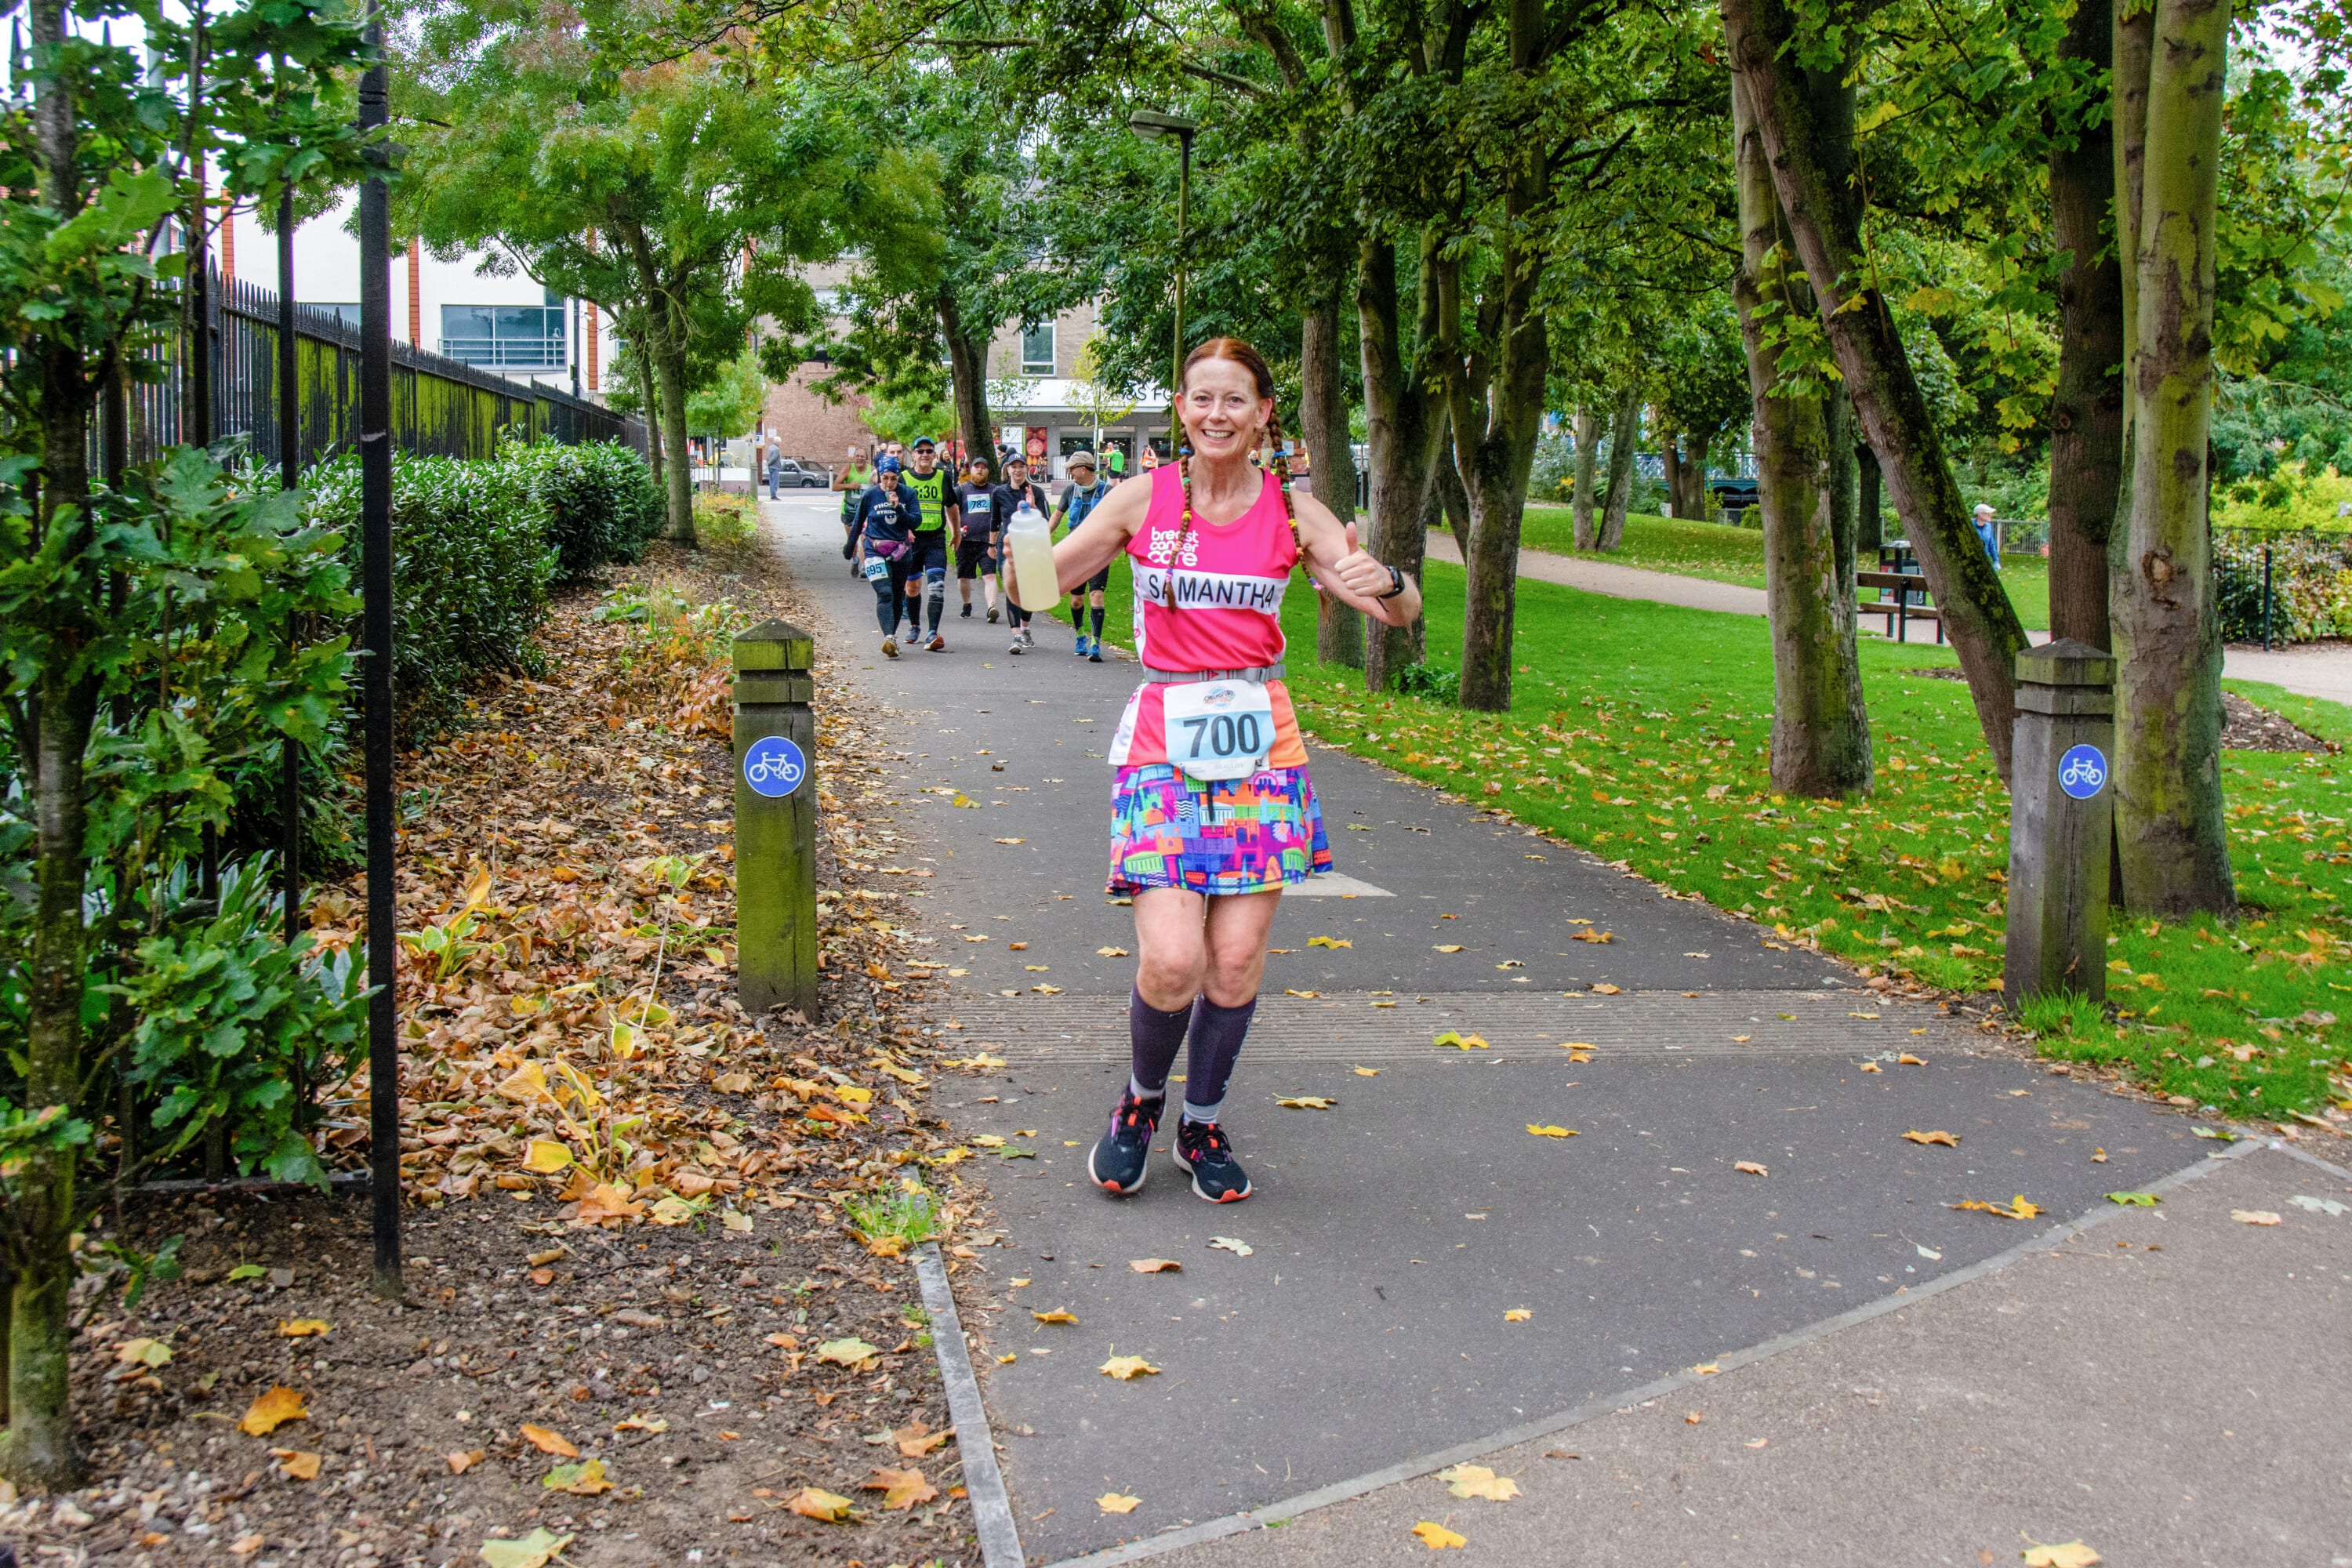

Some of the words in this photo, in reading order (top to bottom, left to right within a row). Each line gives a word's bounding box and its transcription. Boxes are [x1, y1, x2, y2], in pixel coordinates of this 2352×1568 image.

[971, 499, 987, 509] 782
[1149, 540, 1199, 553] caner
[866, 564, 882, 576] 695
[1183, 713, 1260, 758] 700
